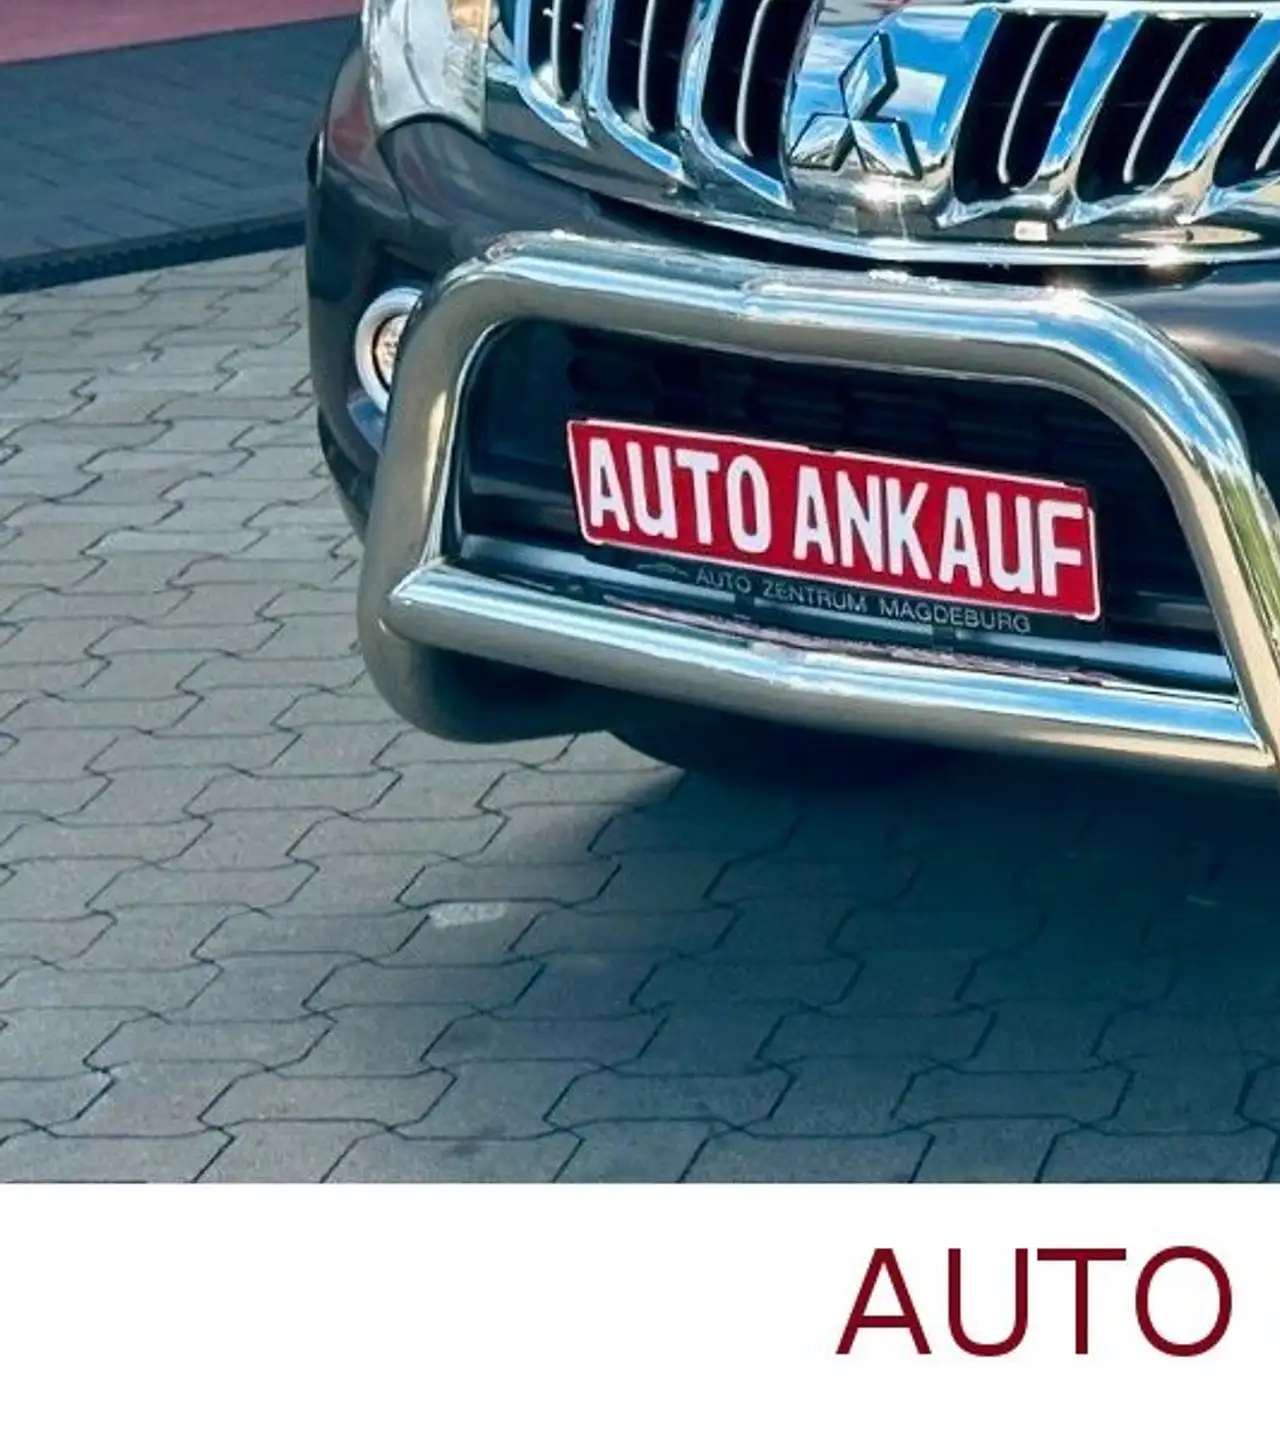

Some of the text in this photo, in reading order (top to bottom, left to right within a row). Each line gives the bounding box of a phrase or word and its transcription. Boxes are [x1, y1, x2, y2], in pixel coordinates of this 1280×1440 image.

[588, 437, 1085, 597] AUTO ANKAUF
[695, 568, 1032, 634] AUTO ZENTRUM MAGDEBURG
